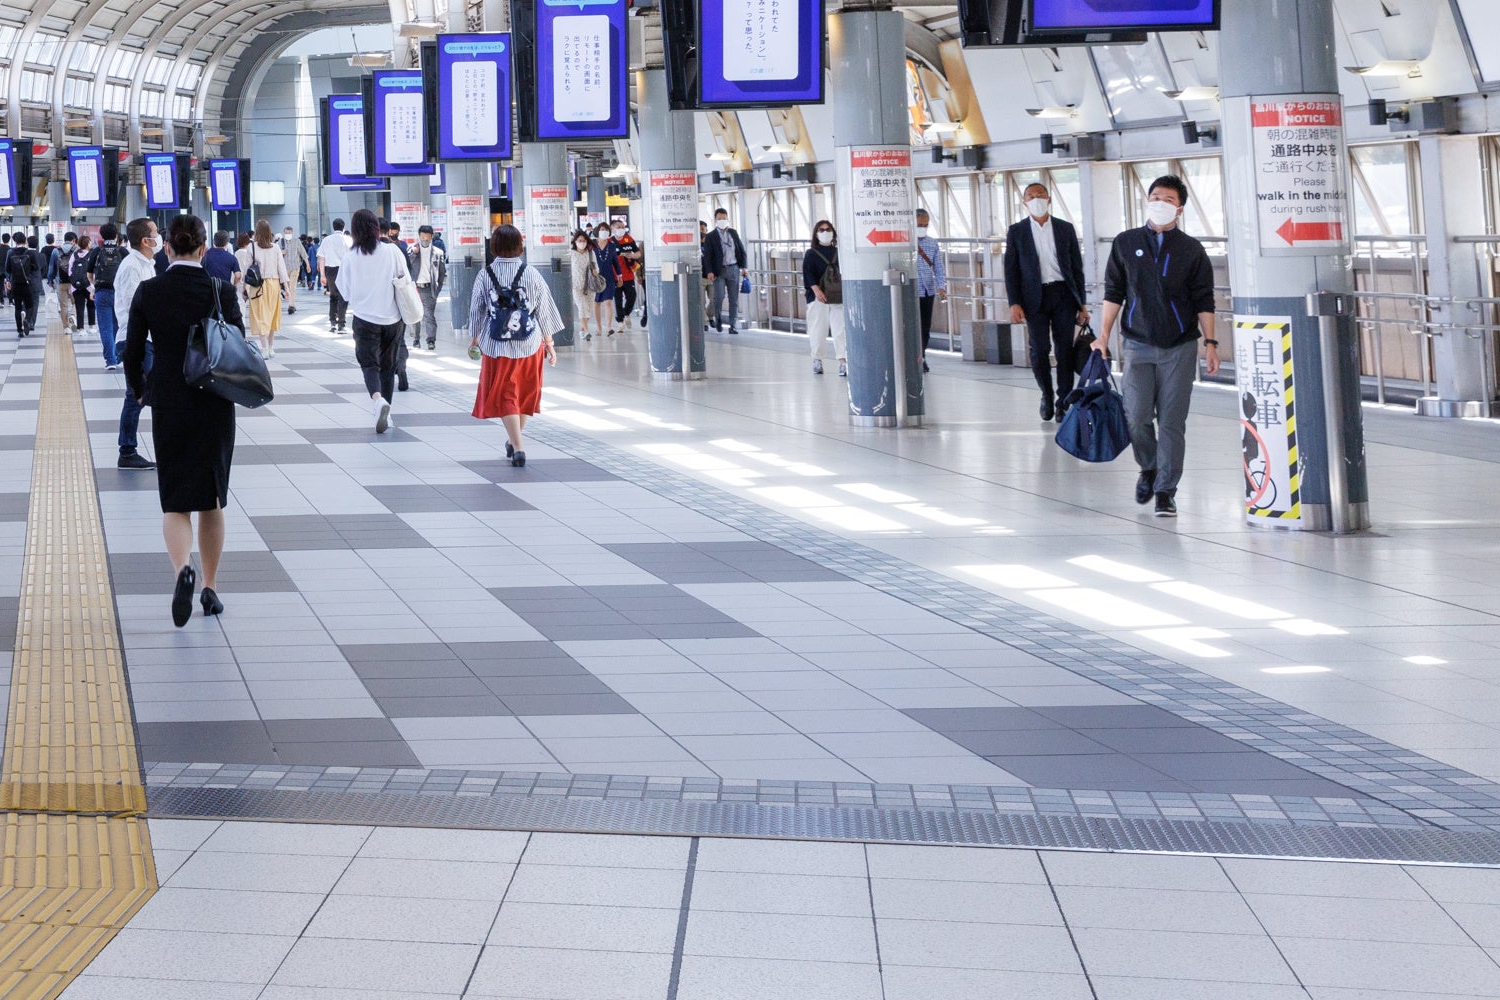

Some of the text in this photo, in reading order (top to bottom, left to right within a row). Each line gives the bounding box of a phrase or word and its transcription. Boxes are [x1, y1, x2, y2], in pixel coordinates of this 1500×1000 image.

[1285, 114, 1326, 123] NOTICE
[1271, 144, 1337, 158] 通路中央を
[1262, 161, 1337, 173] ご通行くださ
[1294, 177, 1326, 186] Please
[1256, 191, 1285, 200] walk
[1288, 191, 1299, 200] in
[1303, 190, 1321, 200] the
[1270, 205, 1303, 215] during
[1306, 204, 1326, 212] rush
[1252, 336, 1281, 429] 自転車
